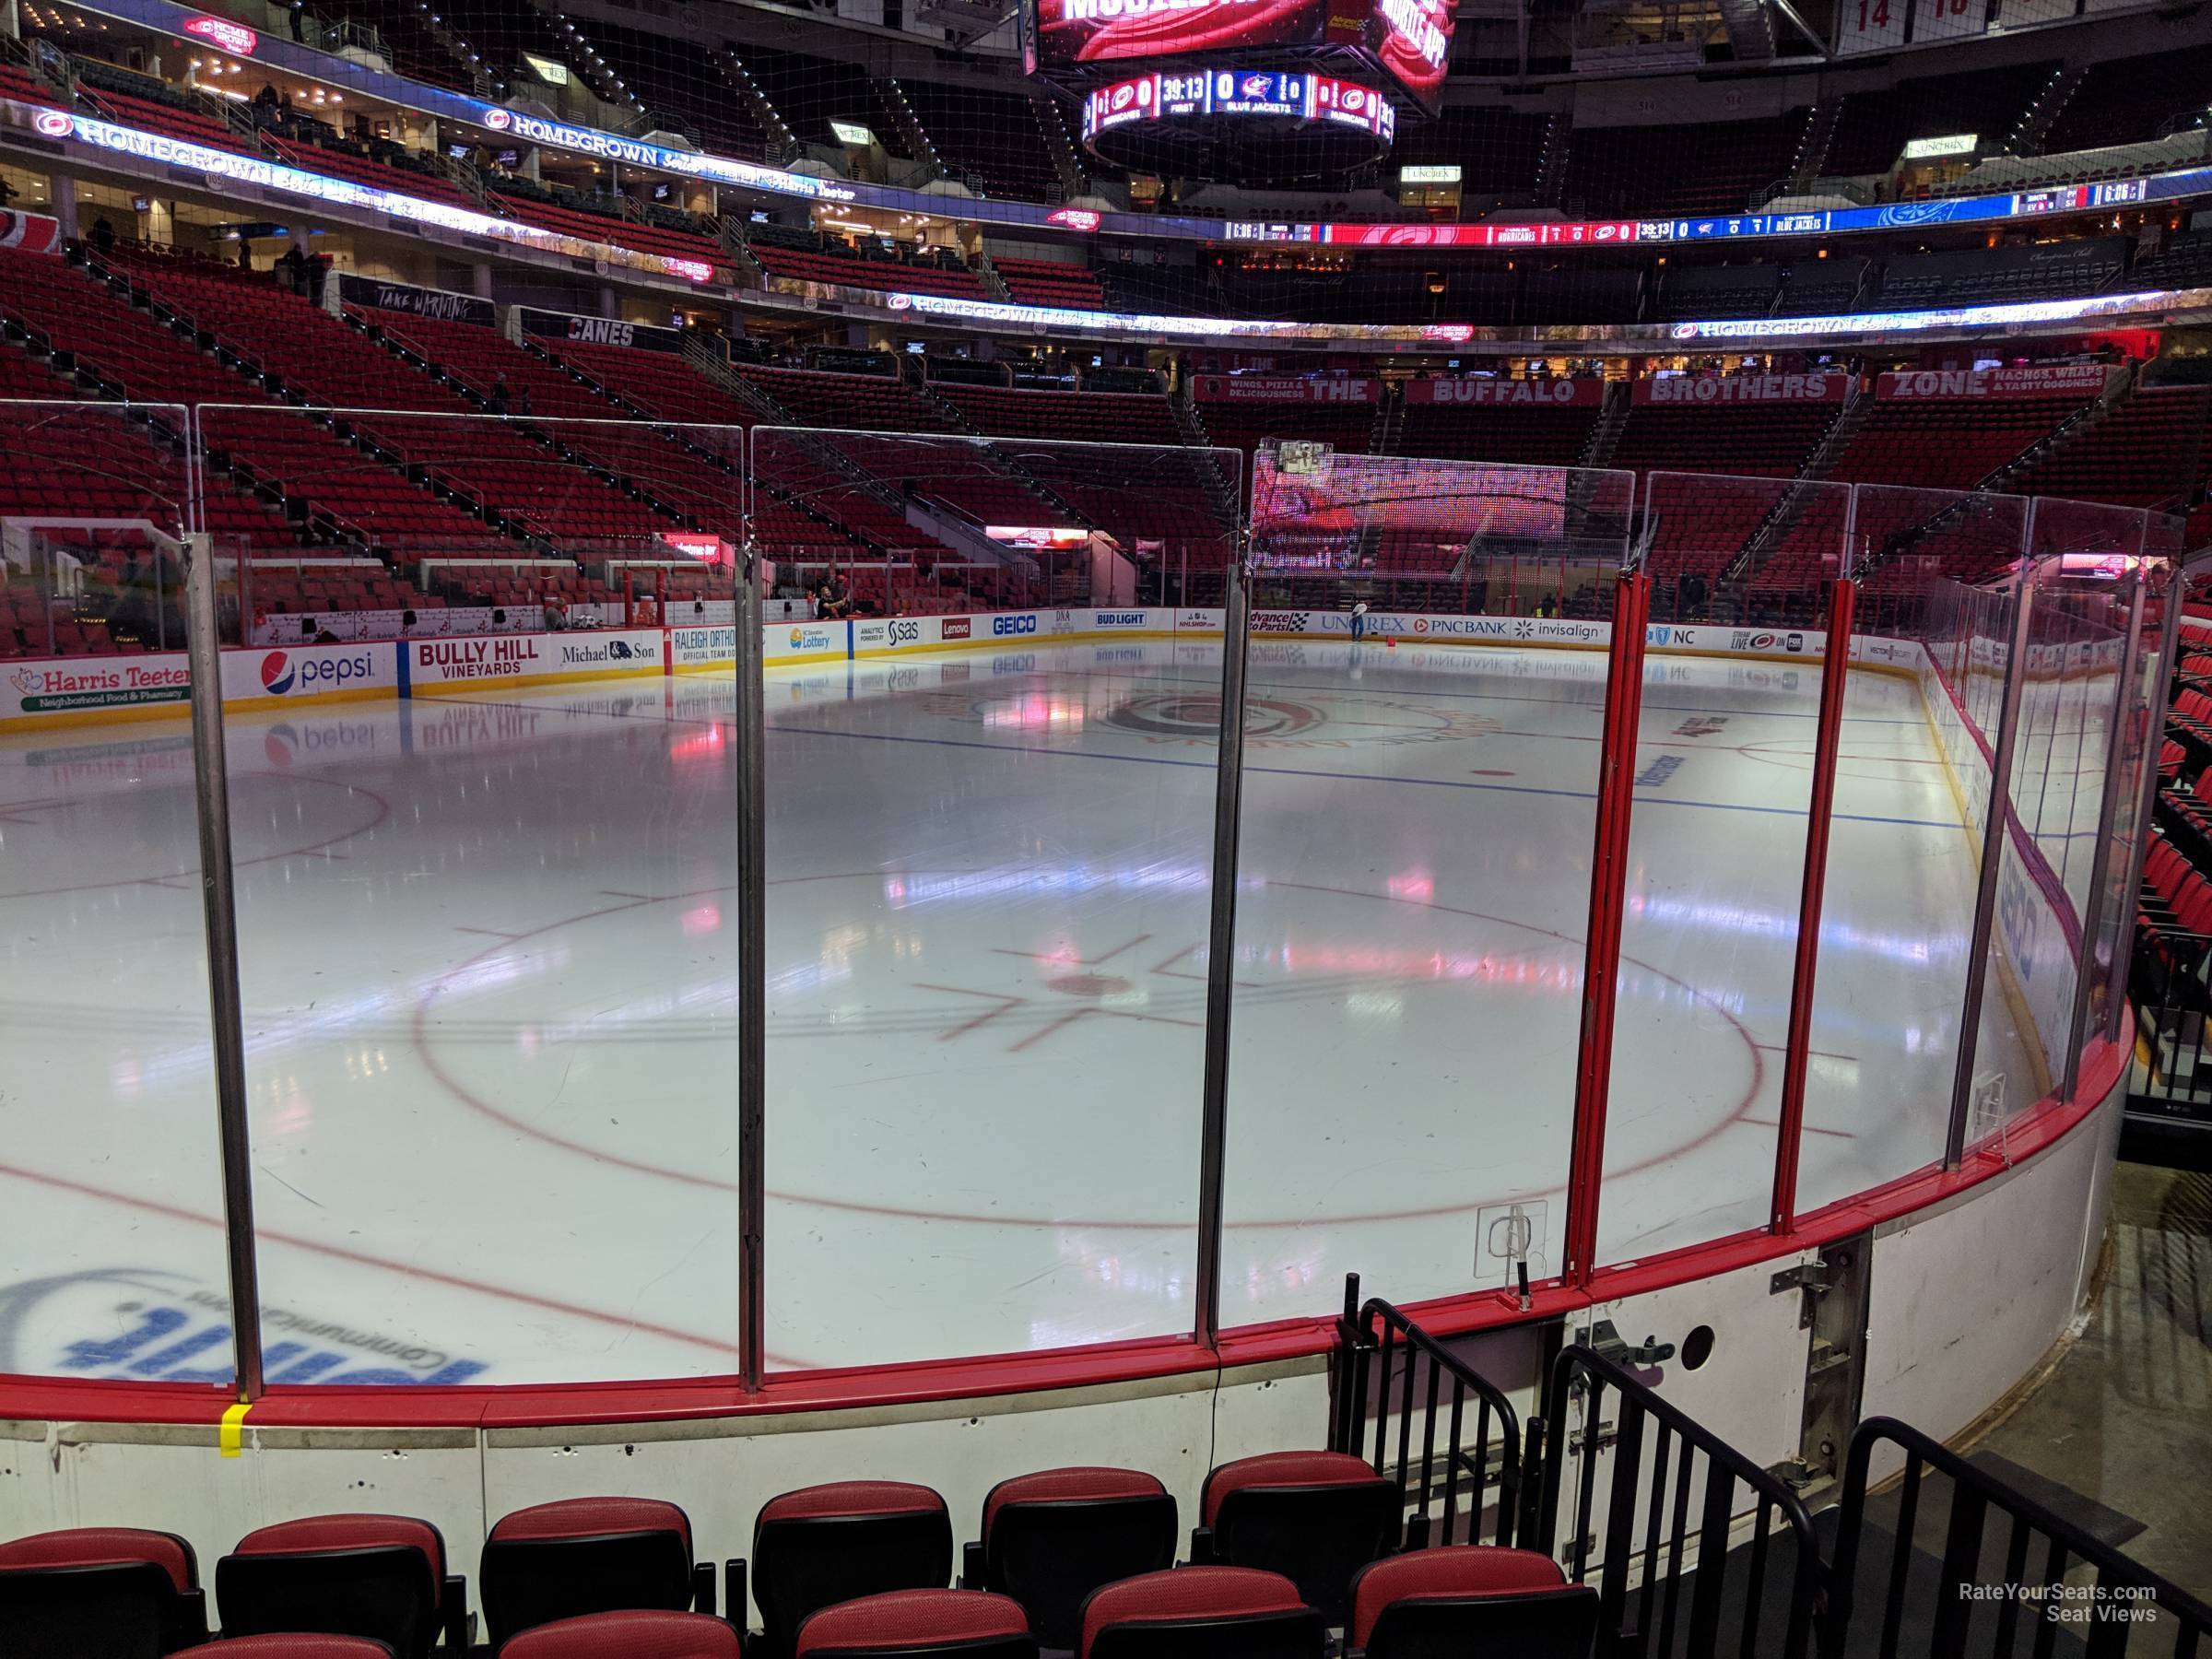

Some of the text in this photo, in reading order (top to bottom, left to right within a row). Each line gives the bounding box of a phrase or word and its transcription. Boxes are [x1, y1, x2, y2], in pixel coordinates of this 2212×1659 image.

[1423, 21, 1445, 68] APP
[1137, 80, 1151, 105] 0
[1163, 76, 1204, 101] 39:13
[1218, 74, 1233, 99] 0
[1289, 81, 1300, 99] 0
[1320, 86, 1329, 102] 0
[1171, 103, 1194, 113] FIRST
[1227, 101, 1291, 112] BLUE JACKETS
[513, 114, 659, 166] HOMEGROWN
[1921, 140, 1965, 152] UNC REX
[81, 121, 274, 185] HOMEGROWN
[207, 174, 222, 185] 105
[1413, 170, 1450, 178] UNC REX
[2105, 184, 2128, 202] 6:06
[1619, 225, 1630, 240] 0
[1641, 223, 1669, 236] 39:13
[1678, 222, 1688, 237] 0
[1776, 218, 1821, 231] BLUE JACKETS
[1498, 230, 1535, 242] HURRICANES
[377, 287, 471, 320] TAKE WARNING
[915, 298, 1047, 323] HOMEGROWN
[568, 318, 634, 347] CANES
[1703, 317, 1856, 336] HOMEGROWN
[1994, 367, 2103, 382] NACHOS, WRAPS
[1230, 380, 1265, 390] WINGS,
[1266, 381, 1294, 390] PIZZA
[1309, 380, 1369, 401] THE
[1433, 380, 1575, 403] BUFFALO
[1650, 375, 1828, 401] BROTHERS
[1892, 371, 1988, 396] ZONE
[1994, 377, 2103, 391] & TASTY GOODNESS
[1230, 389, 1304, 398] DELICIOUSNESS
[1055, 610, 1070, 621] DNA
[1097, 614, 1145, 625] BUD LIGHT
[1250, 612, 1289, 623] dvance
[1366, 616, 1406, 631] REX
[860, 627, 884, 635] ANALYTICS
[944, 622, 969, 635] Lenovo
[993, 615, 1036, 635] GEICO
[1258, 622, 1288, 631] Parts
[1431, 619, 1507, 634] PNC BANK
[1538, 622, 1599, 641] invisalign
[675, 630, 708, 650] RALEIGH
[803, 634, 830, 649] Lottery
[1674, 629, 1695, 645] NC
[1731, 637, 1785, 650] LIVE ON
[419, 639, 539, 666] BULLY HILL
[561, 641, 655, 664] Michael & Son
[683, 651, 709, 661] OFFICIAL
[710, 651, 726, 660] TEAM
[301, 652, 372, 688] pepsi
[441, 662, 521, 678] VINEYARDS
[43, 668, 120, 692] Harris
[40, 689, 183, 709] Neighborhood Food & Pharmacy
